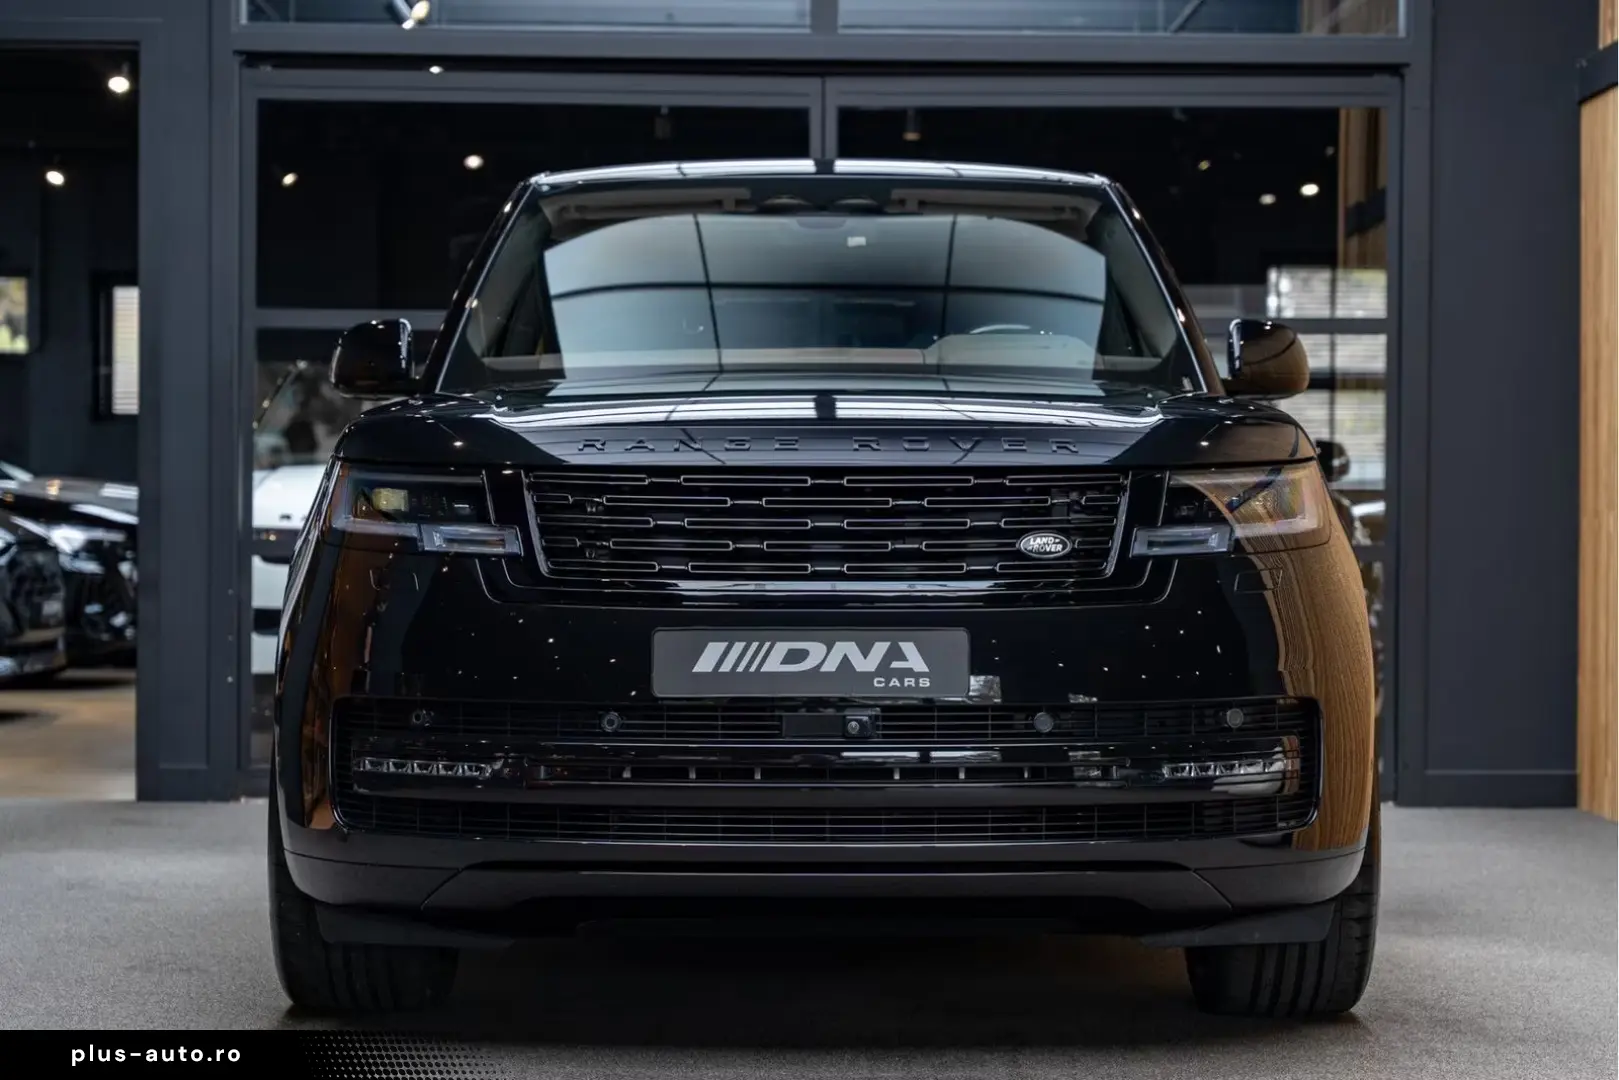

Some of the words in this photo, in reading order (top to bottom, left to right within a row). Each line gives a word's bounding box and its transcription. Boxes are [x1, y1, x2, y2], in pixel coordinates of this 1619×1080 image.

[577, 436, 801, 452] RANGE
[852, 436, 1080, 454] ROVER
[1032, 544, 1063, 552] ROVER
[760, 641, 930, 672] DNA
[873, 677, 931, 687] CARS
